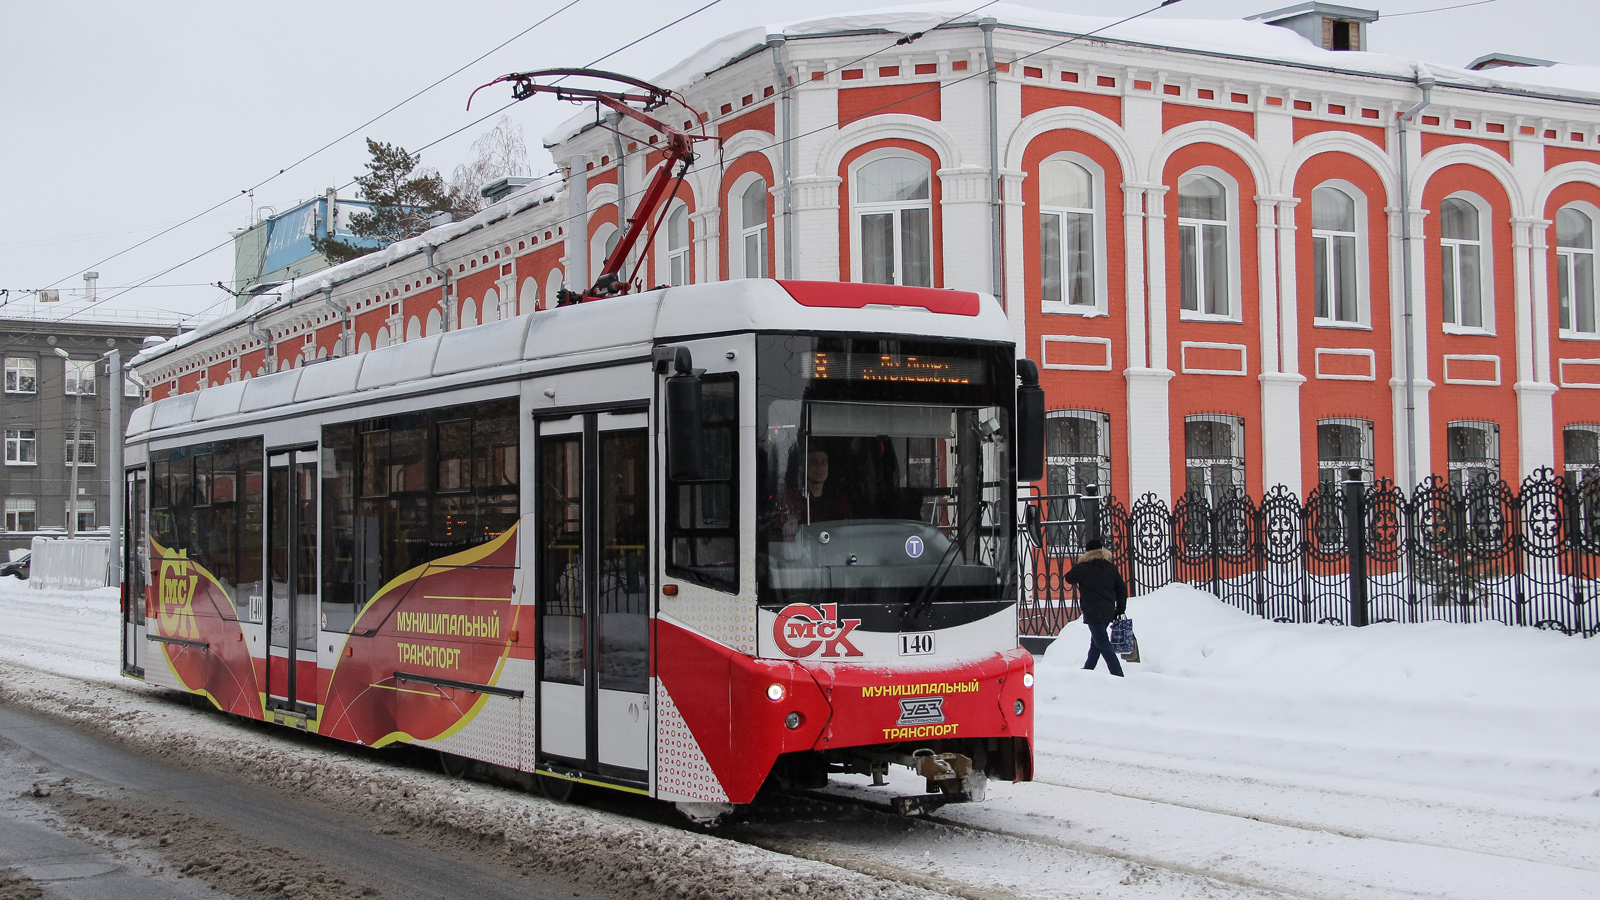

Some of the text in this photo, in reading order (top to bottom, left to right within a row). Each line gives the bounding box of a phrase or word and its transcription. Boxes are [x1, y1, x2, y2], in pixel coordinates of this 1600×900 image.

[250, 598, 262, 620] 140
[397, 610, 500, 639] МУНИЦИПАЛЬНЫЙ
[901, 634, 933, 654] 140
[397, 642, 461, 671] ТРАНСПОРТ
[861, 678, 980, 698] МУНИЦИПАЛЬНЫЙ
[882, 723, 959, 740] ТРАНСПОРТ
